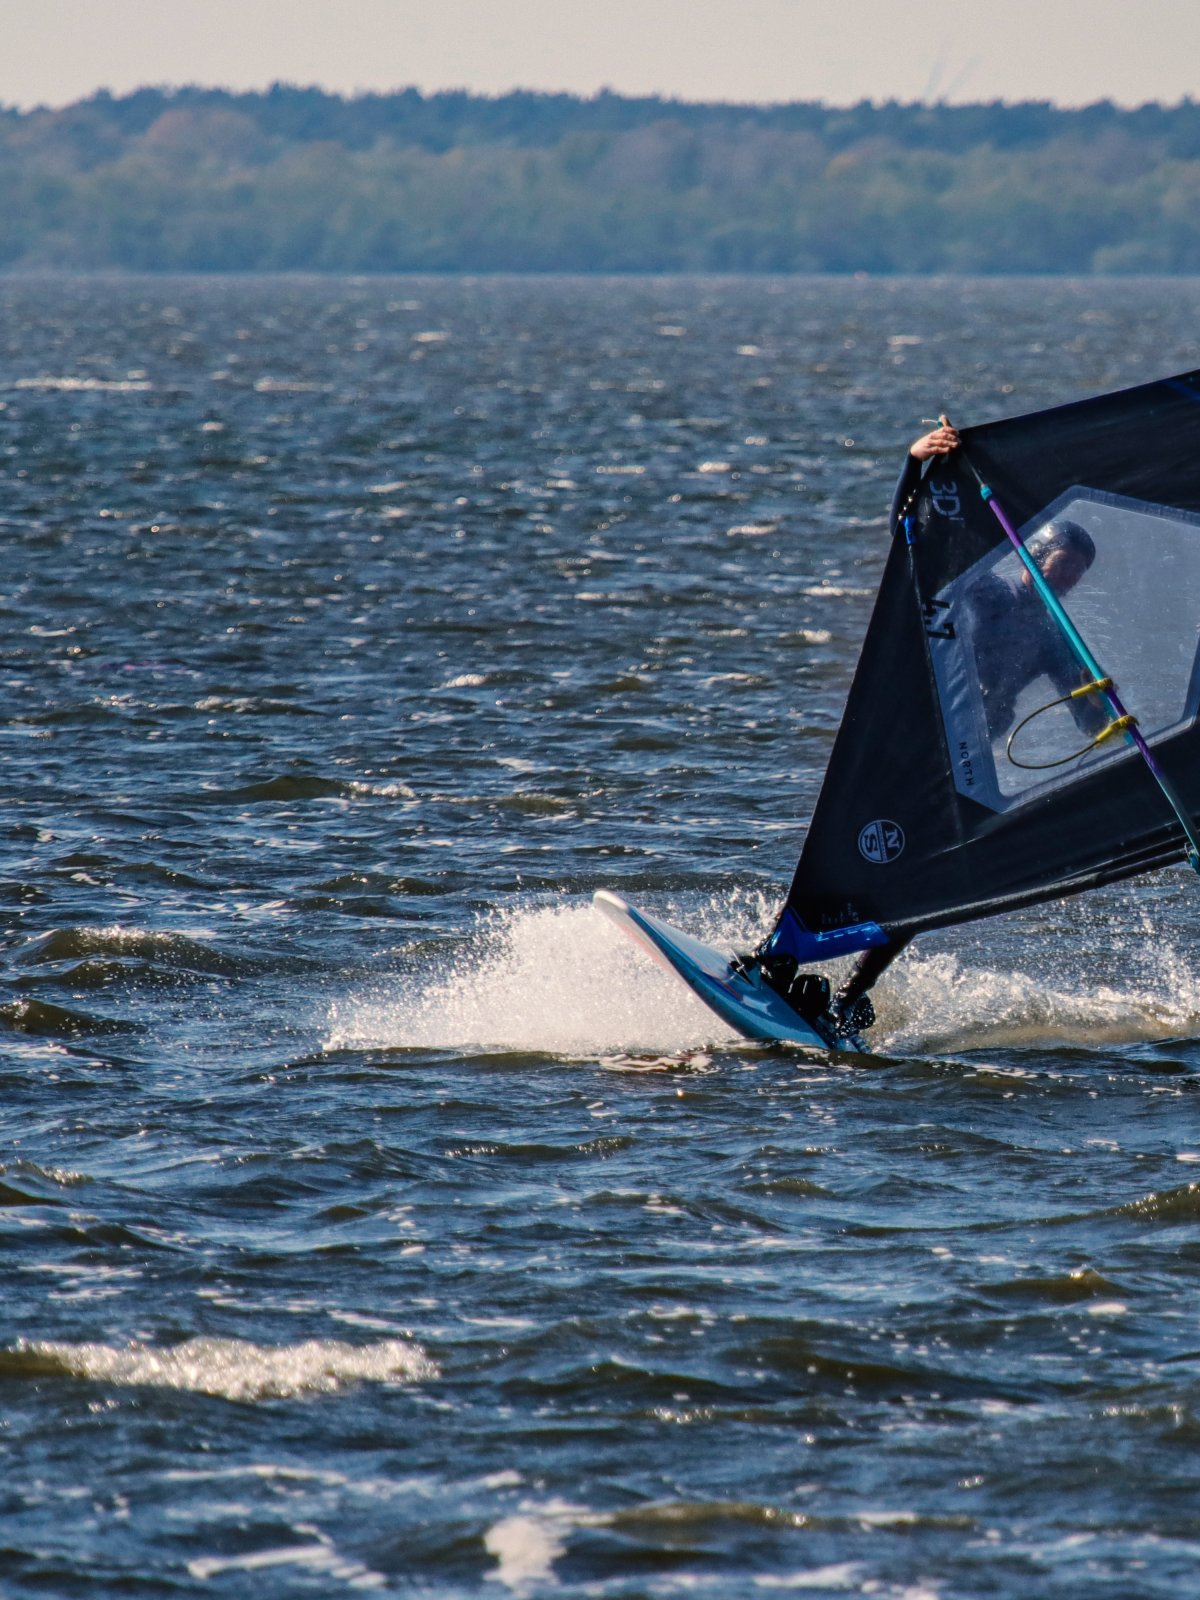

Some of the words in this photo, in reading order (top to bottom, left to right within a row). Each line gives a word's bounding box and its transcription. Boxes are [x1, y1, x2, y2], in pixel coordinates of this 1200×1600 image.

[958, 741, 975, 787] NORTH
[864, 834, 878, 853] S
[884, 828, 900, 849] N
